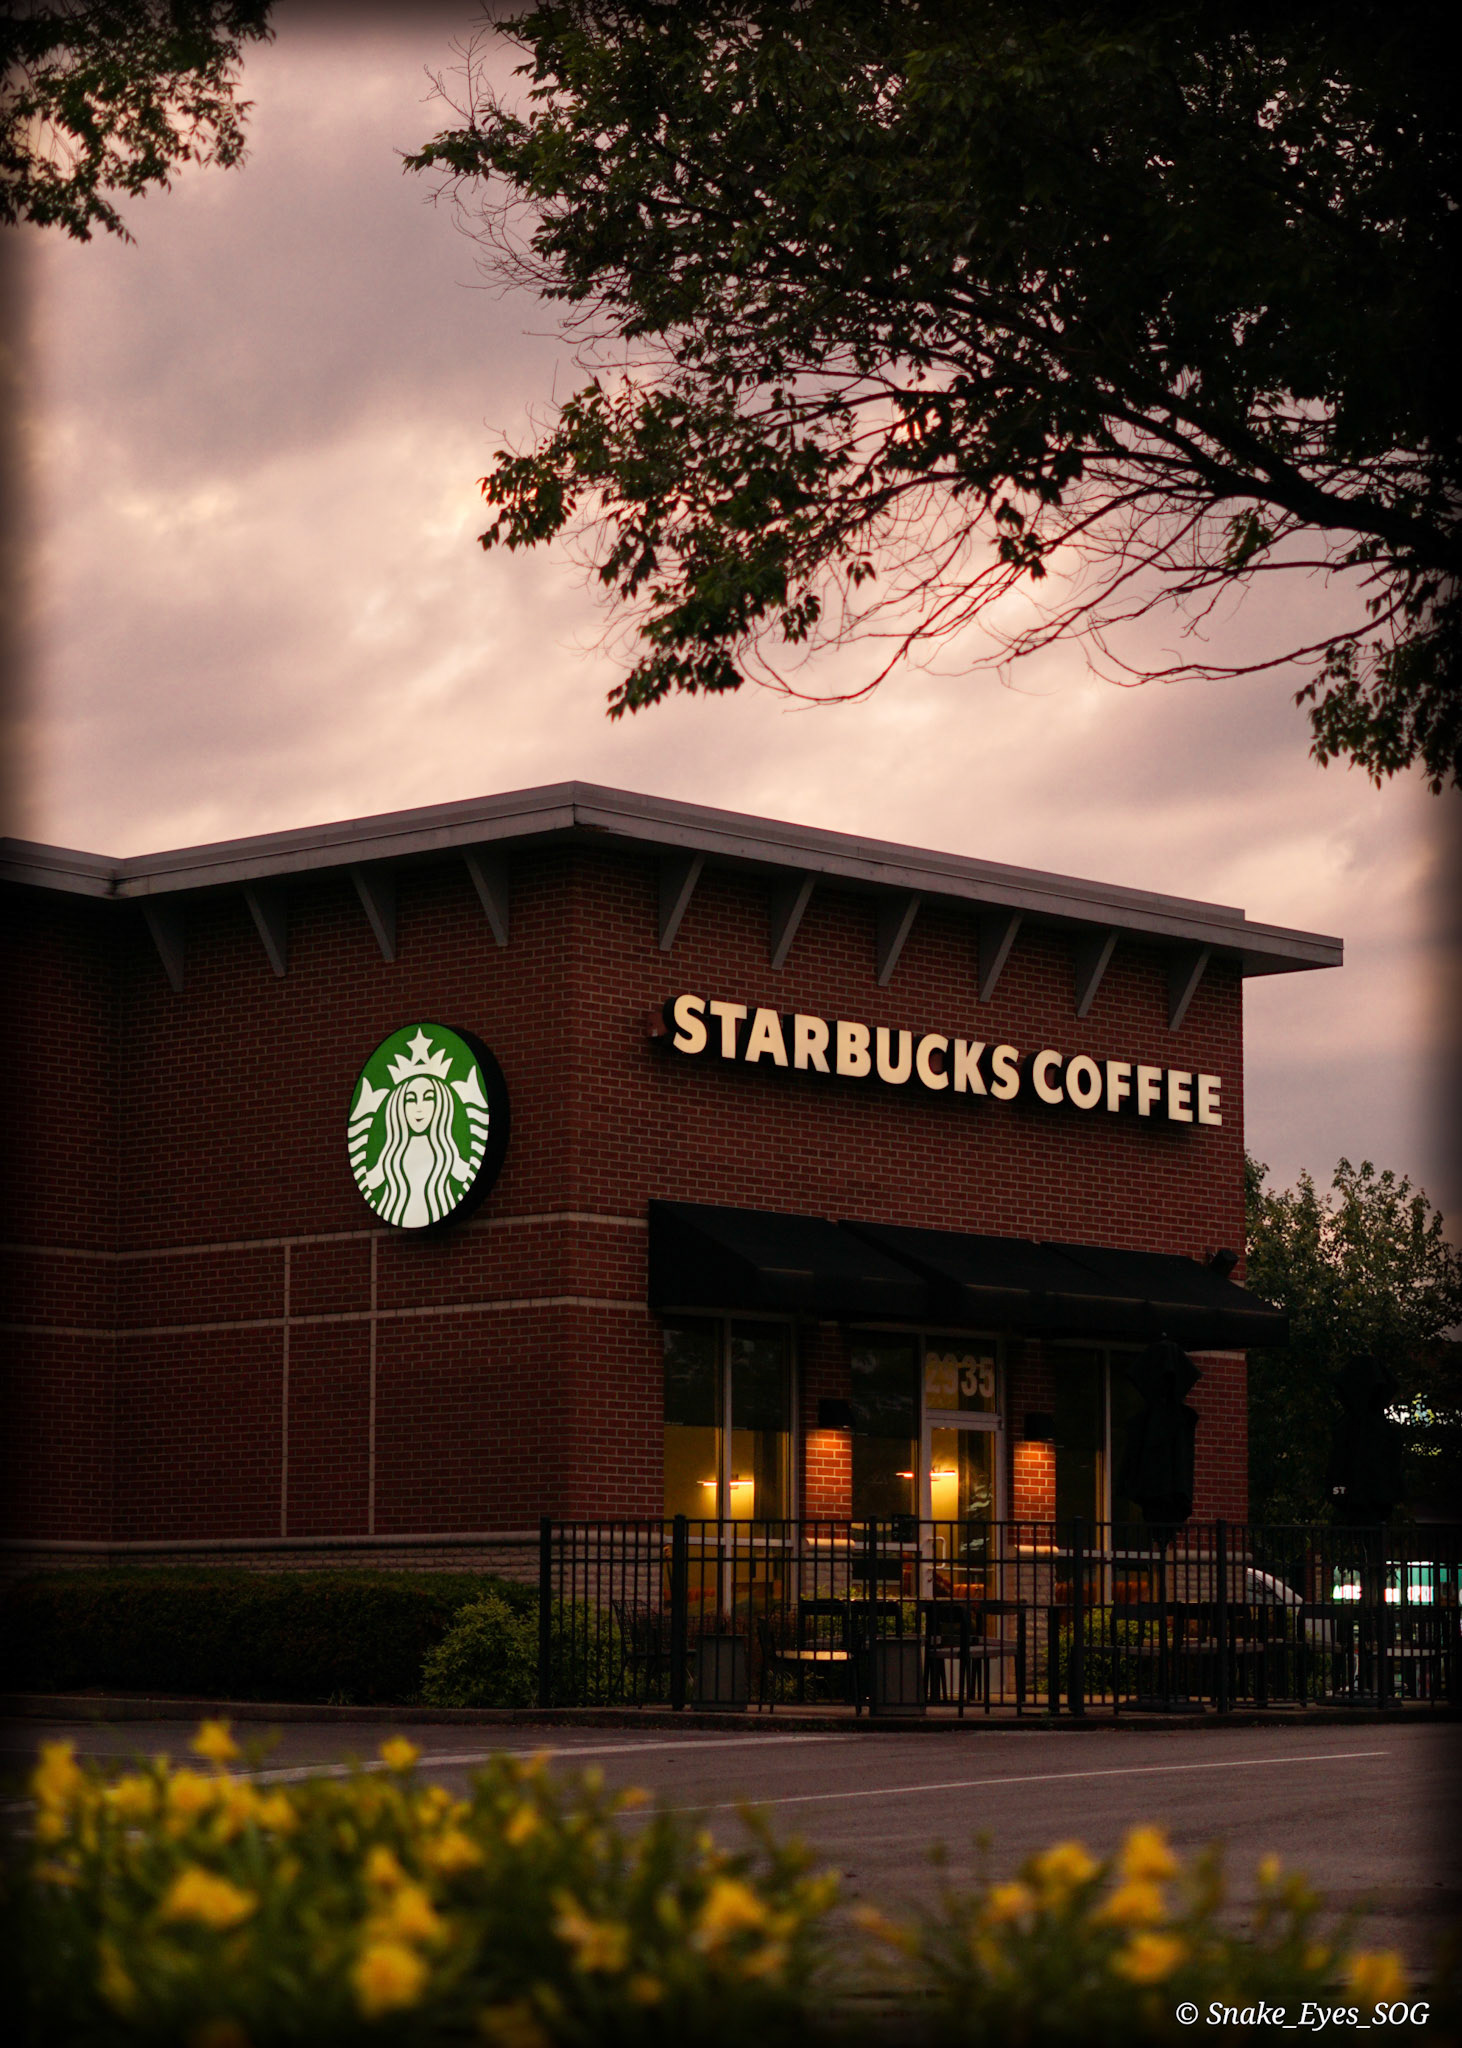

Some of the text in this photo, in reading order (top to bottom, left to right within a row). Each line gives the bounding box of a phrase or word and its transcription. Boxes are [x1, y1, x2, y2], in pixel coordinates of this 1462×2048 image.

[671, 993, 1223, 1127] STARBUCKS COFFEE
[925, 1352, 995, 1398] 2935
